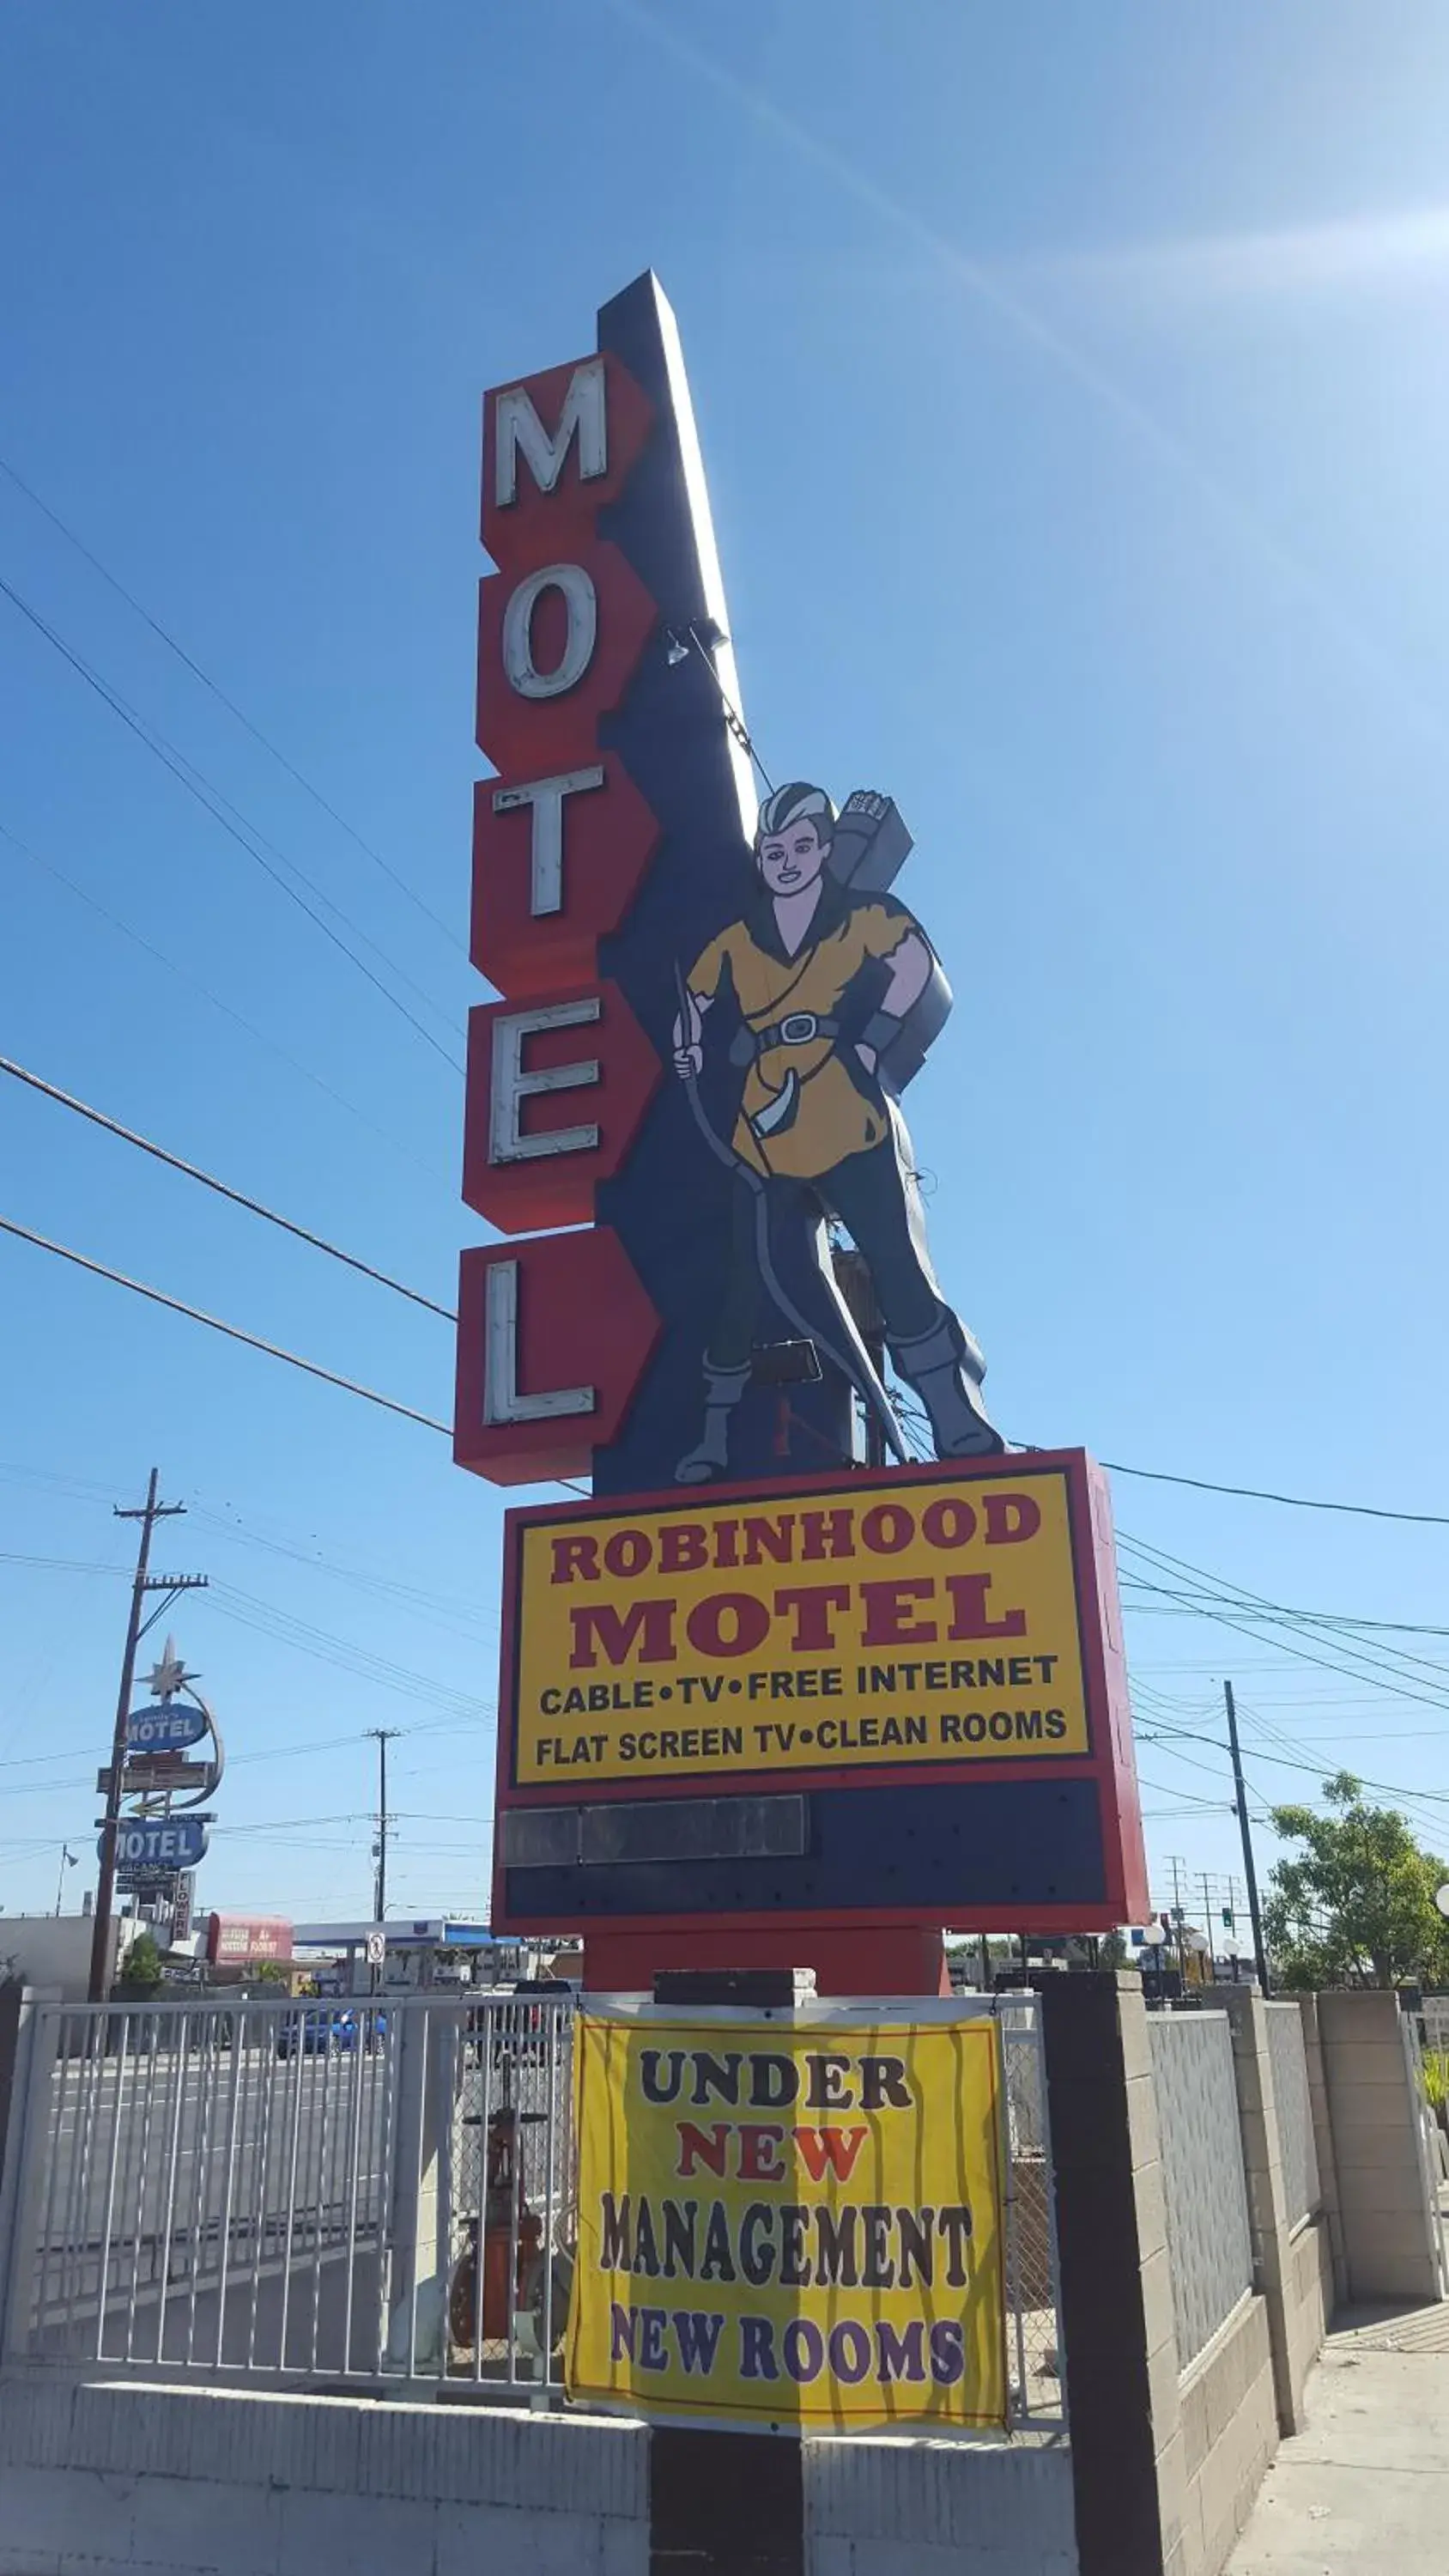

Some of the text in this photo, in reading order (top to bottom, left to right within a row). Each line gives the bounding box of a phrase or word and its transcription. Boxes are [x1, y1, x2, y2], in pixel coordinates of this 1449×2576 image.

[482, 359, 607, 1425] MOTEL
[549, 1493, 1041, 1584] ROBINHOOD
[568, 1572, 1028, 1668] MOTEL
[858, 1656, 1058, 1693] INTERNET
[537, 1735, 609, 1765] FLAT
[618, 1726, 743, 1761] SCREEN
[940, 1709, 1068, 1743] ROOMS
[640, 2050, 912, 2111] UNDER
[675, 2121, 869, 2184] NEW
[600, 2191, 973, 2289] MANAGEMENT
[610, 2303, 965, 2385] NEW ROOMS
